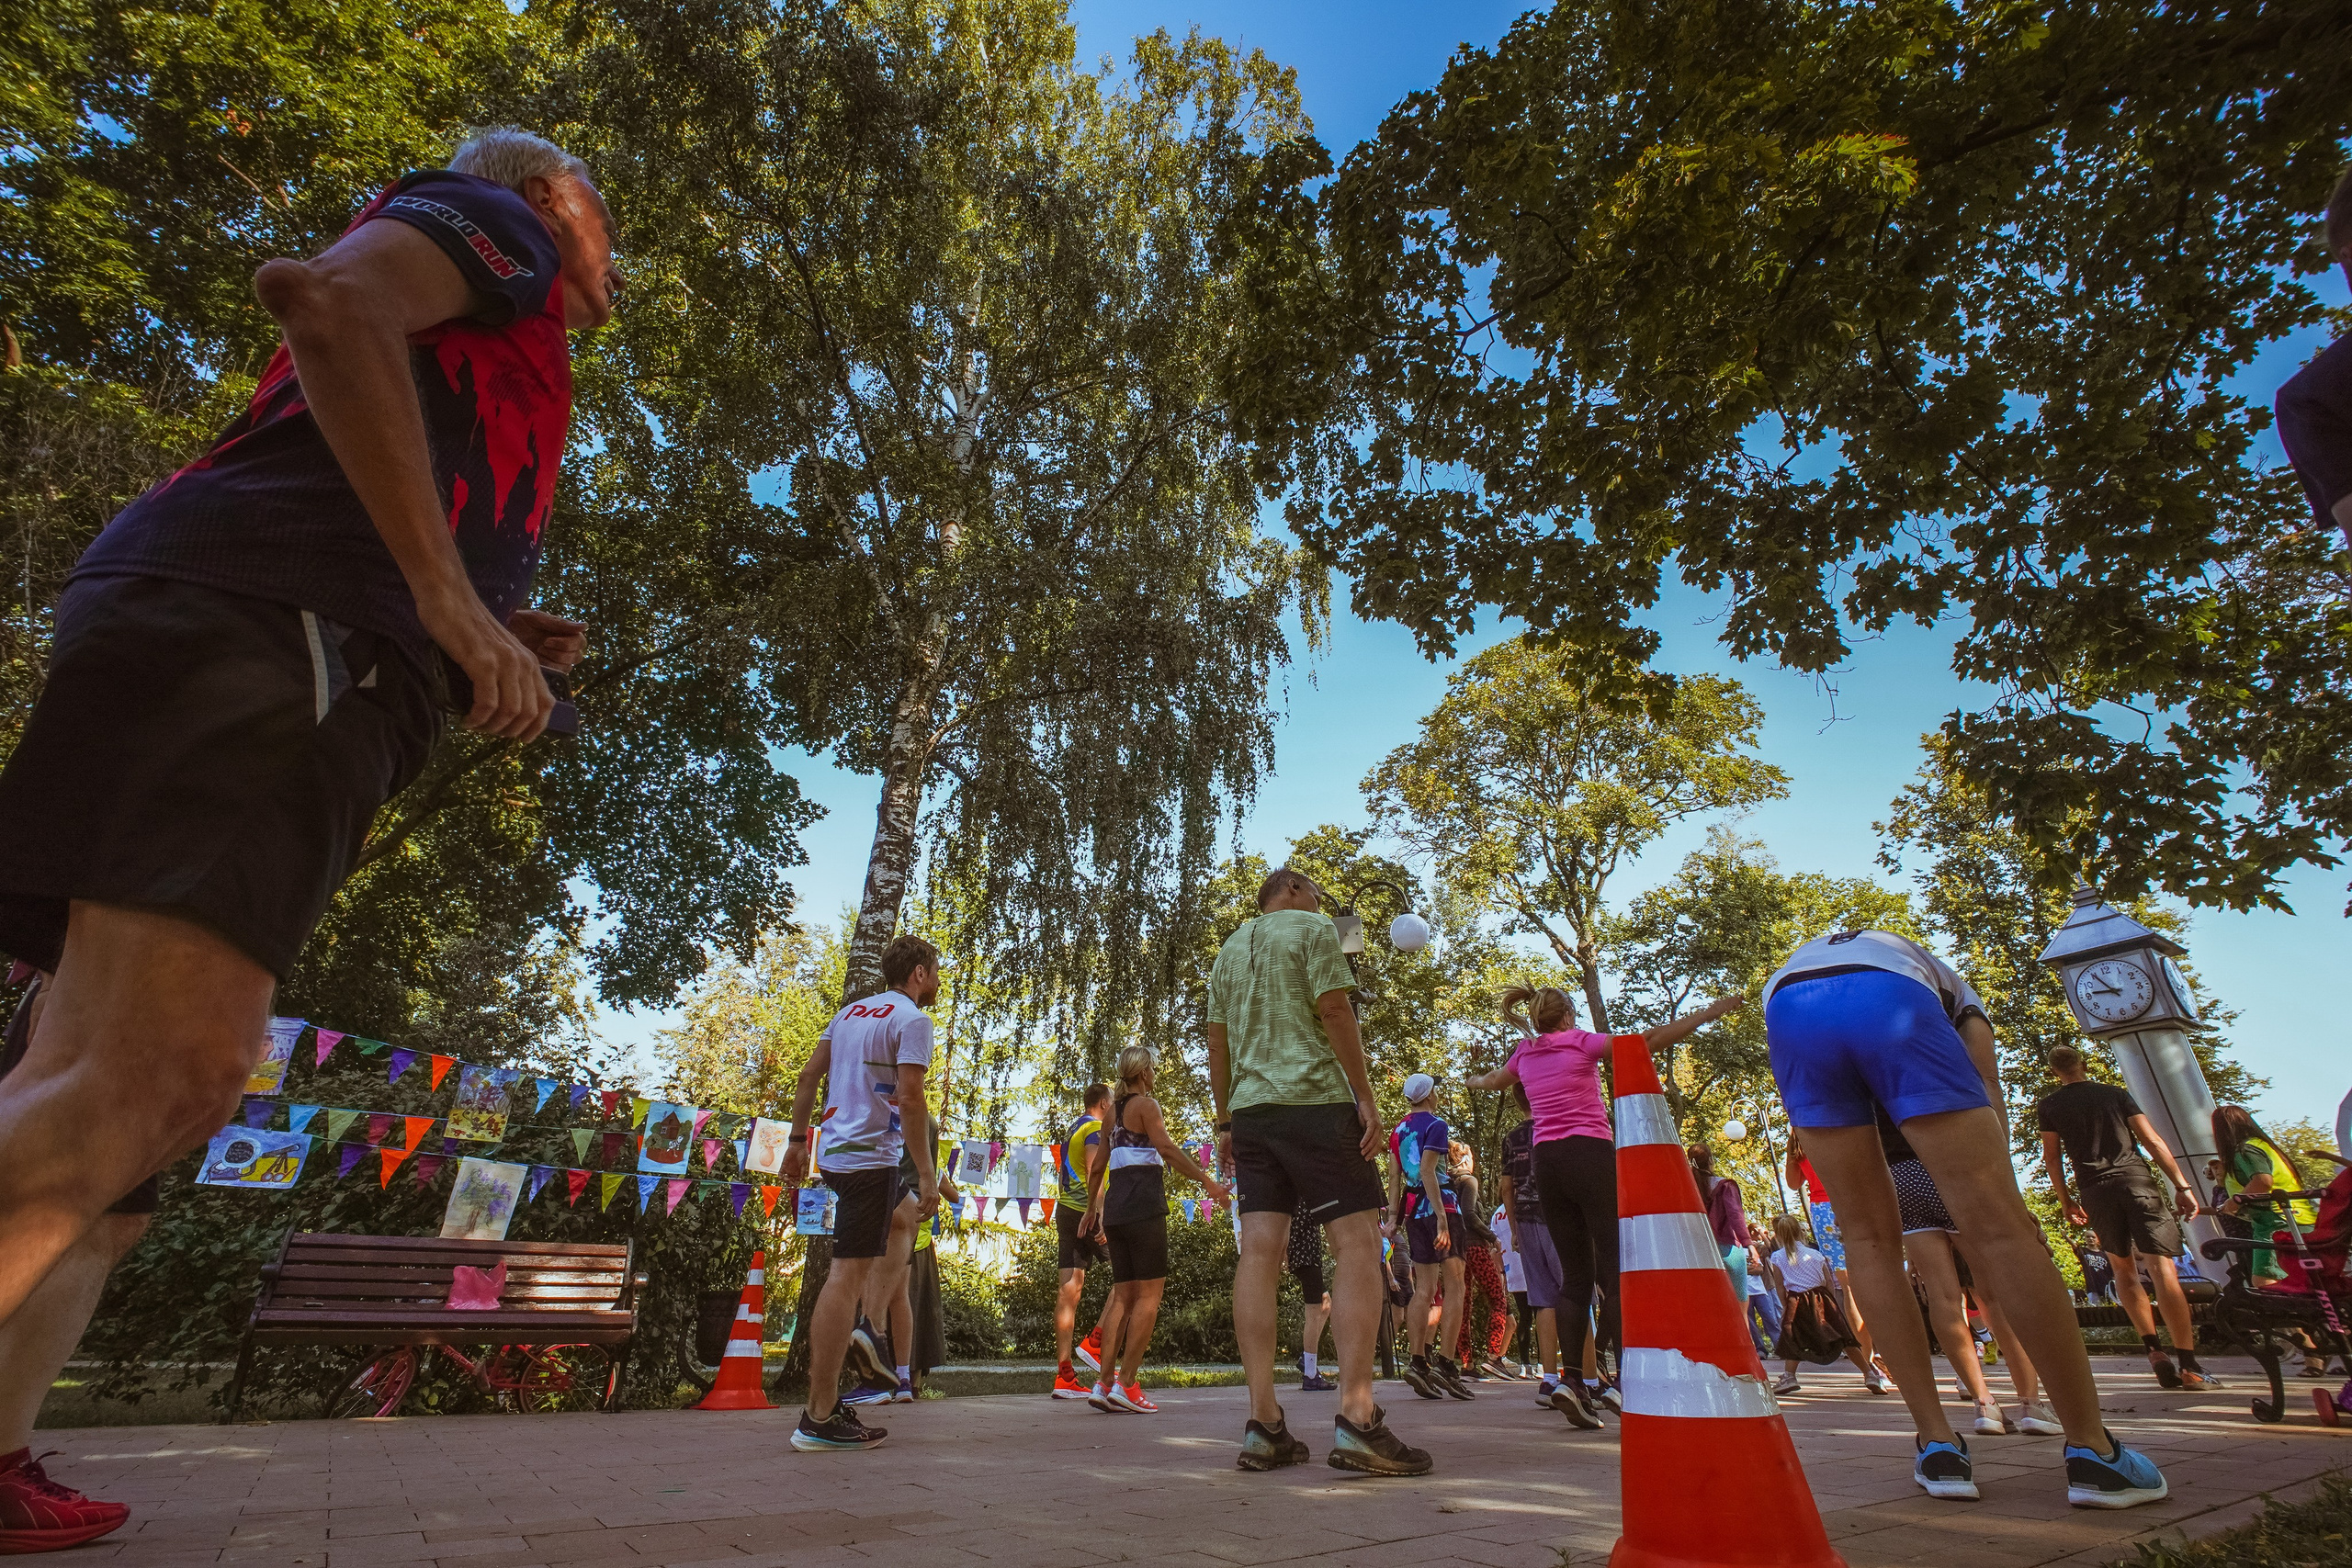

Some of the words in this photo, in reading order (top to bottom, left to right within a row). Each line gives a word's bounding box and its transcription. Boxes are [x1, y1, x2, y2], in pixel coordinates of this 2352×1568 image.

[2100, 965, 2111, 975] 12
[2128, 972, 2135, 980] 2
[2084, 981, 2094, 990] 10
[2135, 981, 2143, 989] 3
[2085, 992, 2093, 1000] 9
[2137, 992, 2144, 1000] 4
[2092, 1001, 2100, 1010] 8
[2131, 1002, 2138, 1010] 5
[2105, 1007, 2111, 1016] 7
[2119, 1007, 2126, 1016] 6
